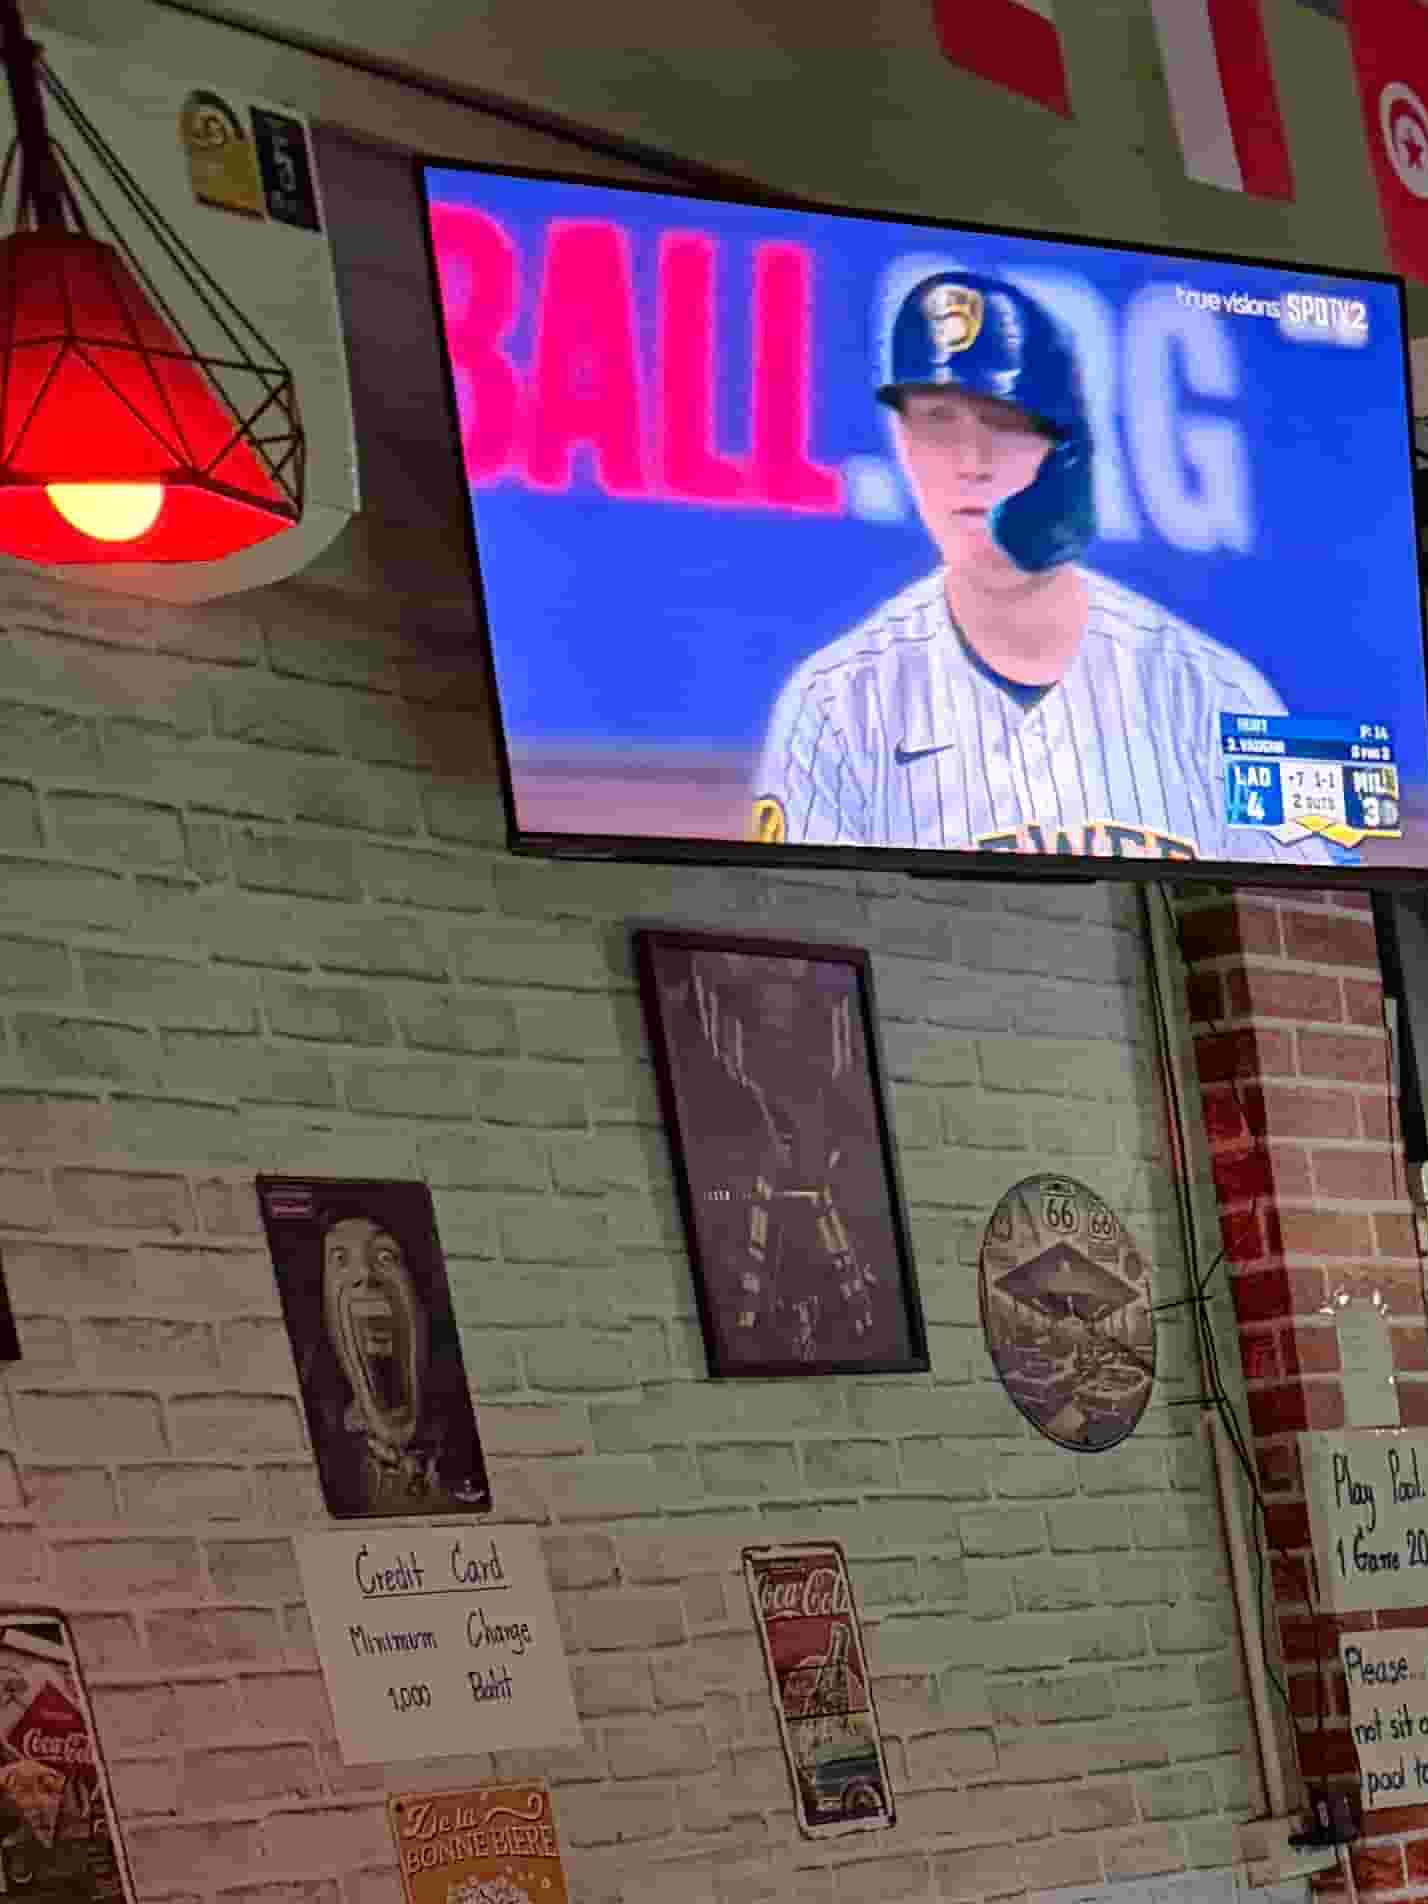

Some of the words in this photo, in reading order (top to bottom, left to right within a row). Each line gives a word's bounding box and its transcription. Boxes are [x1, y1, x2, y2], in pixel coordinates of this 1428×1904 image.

[1047, 1198, 1074, 1229] 66
[1332, 1451, 1377, 1534] Play
[354, 1543, 425, 1595] Credit
[450, 1539, 505, 1584] Card
[1336, 1536, 1347, 1578] 1
[1352, 1525, 1401, 1573] Game
[349, 1624, 438, 1656] Minimum
[1354, 1706, 1383, 1745] not
[1390, 1703, 1413, 1741] sit
[1366, 1753, 1406, 1806] pool
[405, 1830, 489, 1872] BONNE
